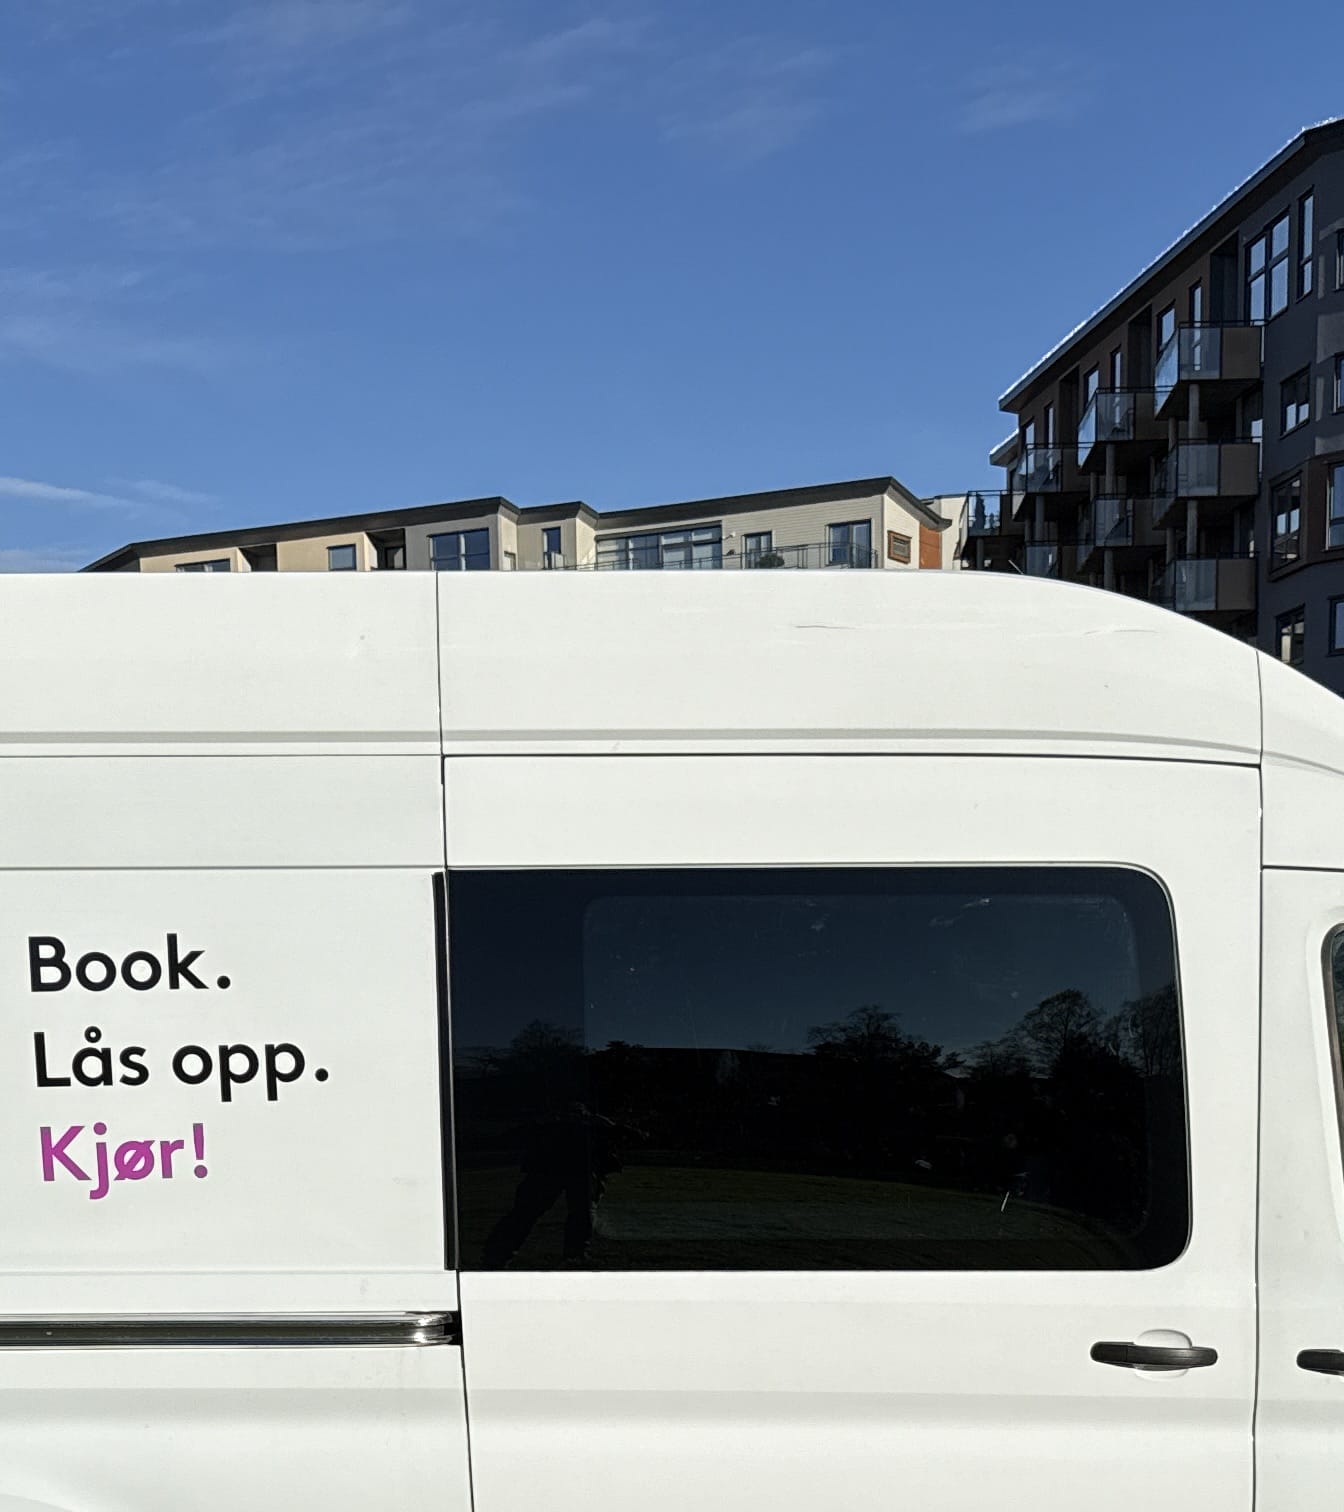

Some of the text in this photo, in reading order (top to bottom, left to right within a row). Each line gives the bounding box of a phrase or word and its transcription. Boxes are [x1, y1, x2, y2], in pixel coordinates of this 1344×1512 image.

[27, 932, 232, 994] Book.
[32, 1024, 330, 1104] Lås opp.
[39, 1121, 209, 1201] Kjør!
